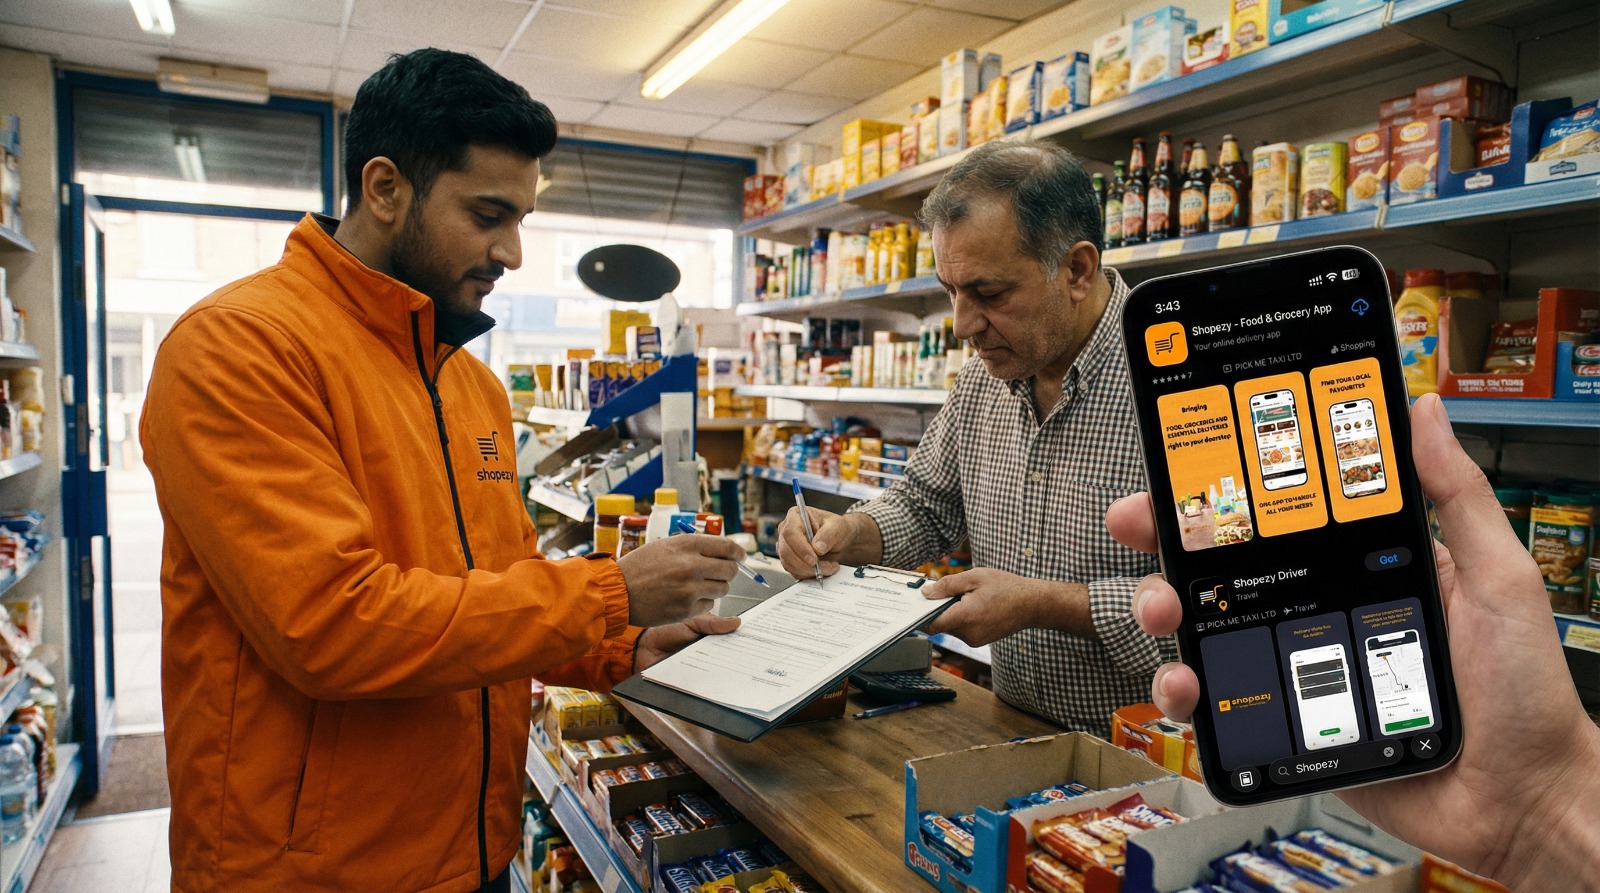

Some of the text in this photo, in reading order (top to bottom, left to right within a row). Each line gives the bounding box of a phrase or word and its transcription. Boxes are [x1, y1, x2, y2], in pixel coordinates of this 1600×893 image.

[1155, 300, 1181, 314] 3:43
[1192, 322, 1232, 338] Shopezy
[1240, 315, 1264, 329] Food
[1265, 313, 1273, 324] &
[1274, 307, 1311, 323] Grocery
[1313, 303, 1332, 317] App
[1194, 330, 1281, 351] Your online delivery app
[1340, 339, 1376, 354] Shopping
[1235, 351, 1302, 371] PICK ME TAXI LTD
[477, 467, 514, 484] shopezy
[1233, 566, 1308, 589] Shopezy Driver
[1236, 590, 1258, 601] Travel
[1294, 602, 1317, 613] Travel
[1207, 609, 1277, 630] PICK ME TAXI LTD
[1296, 758, 1339, 774] Shopezy
